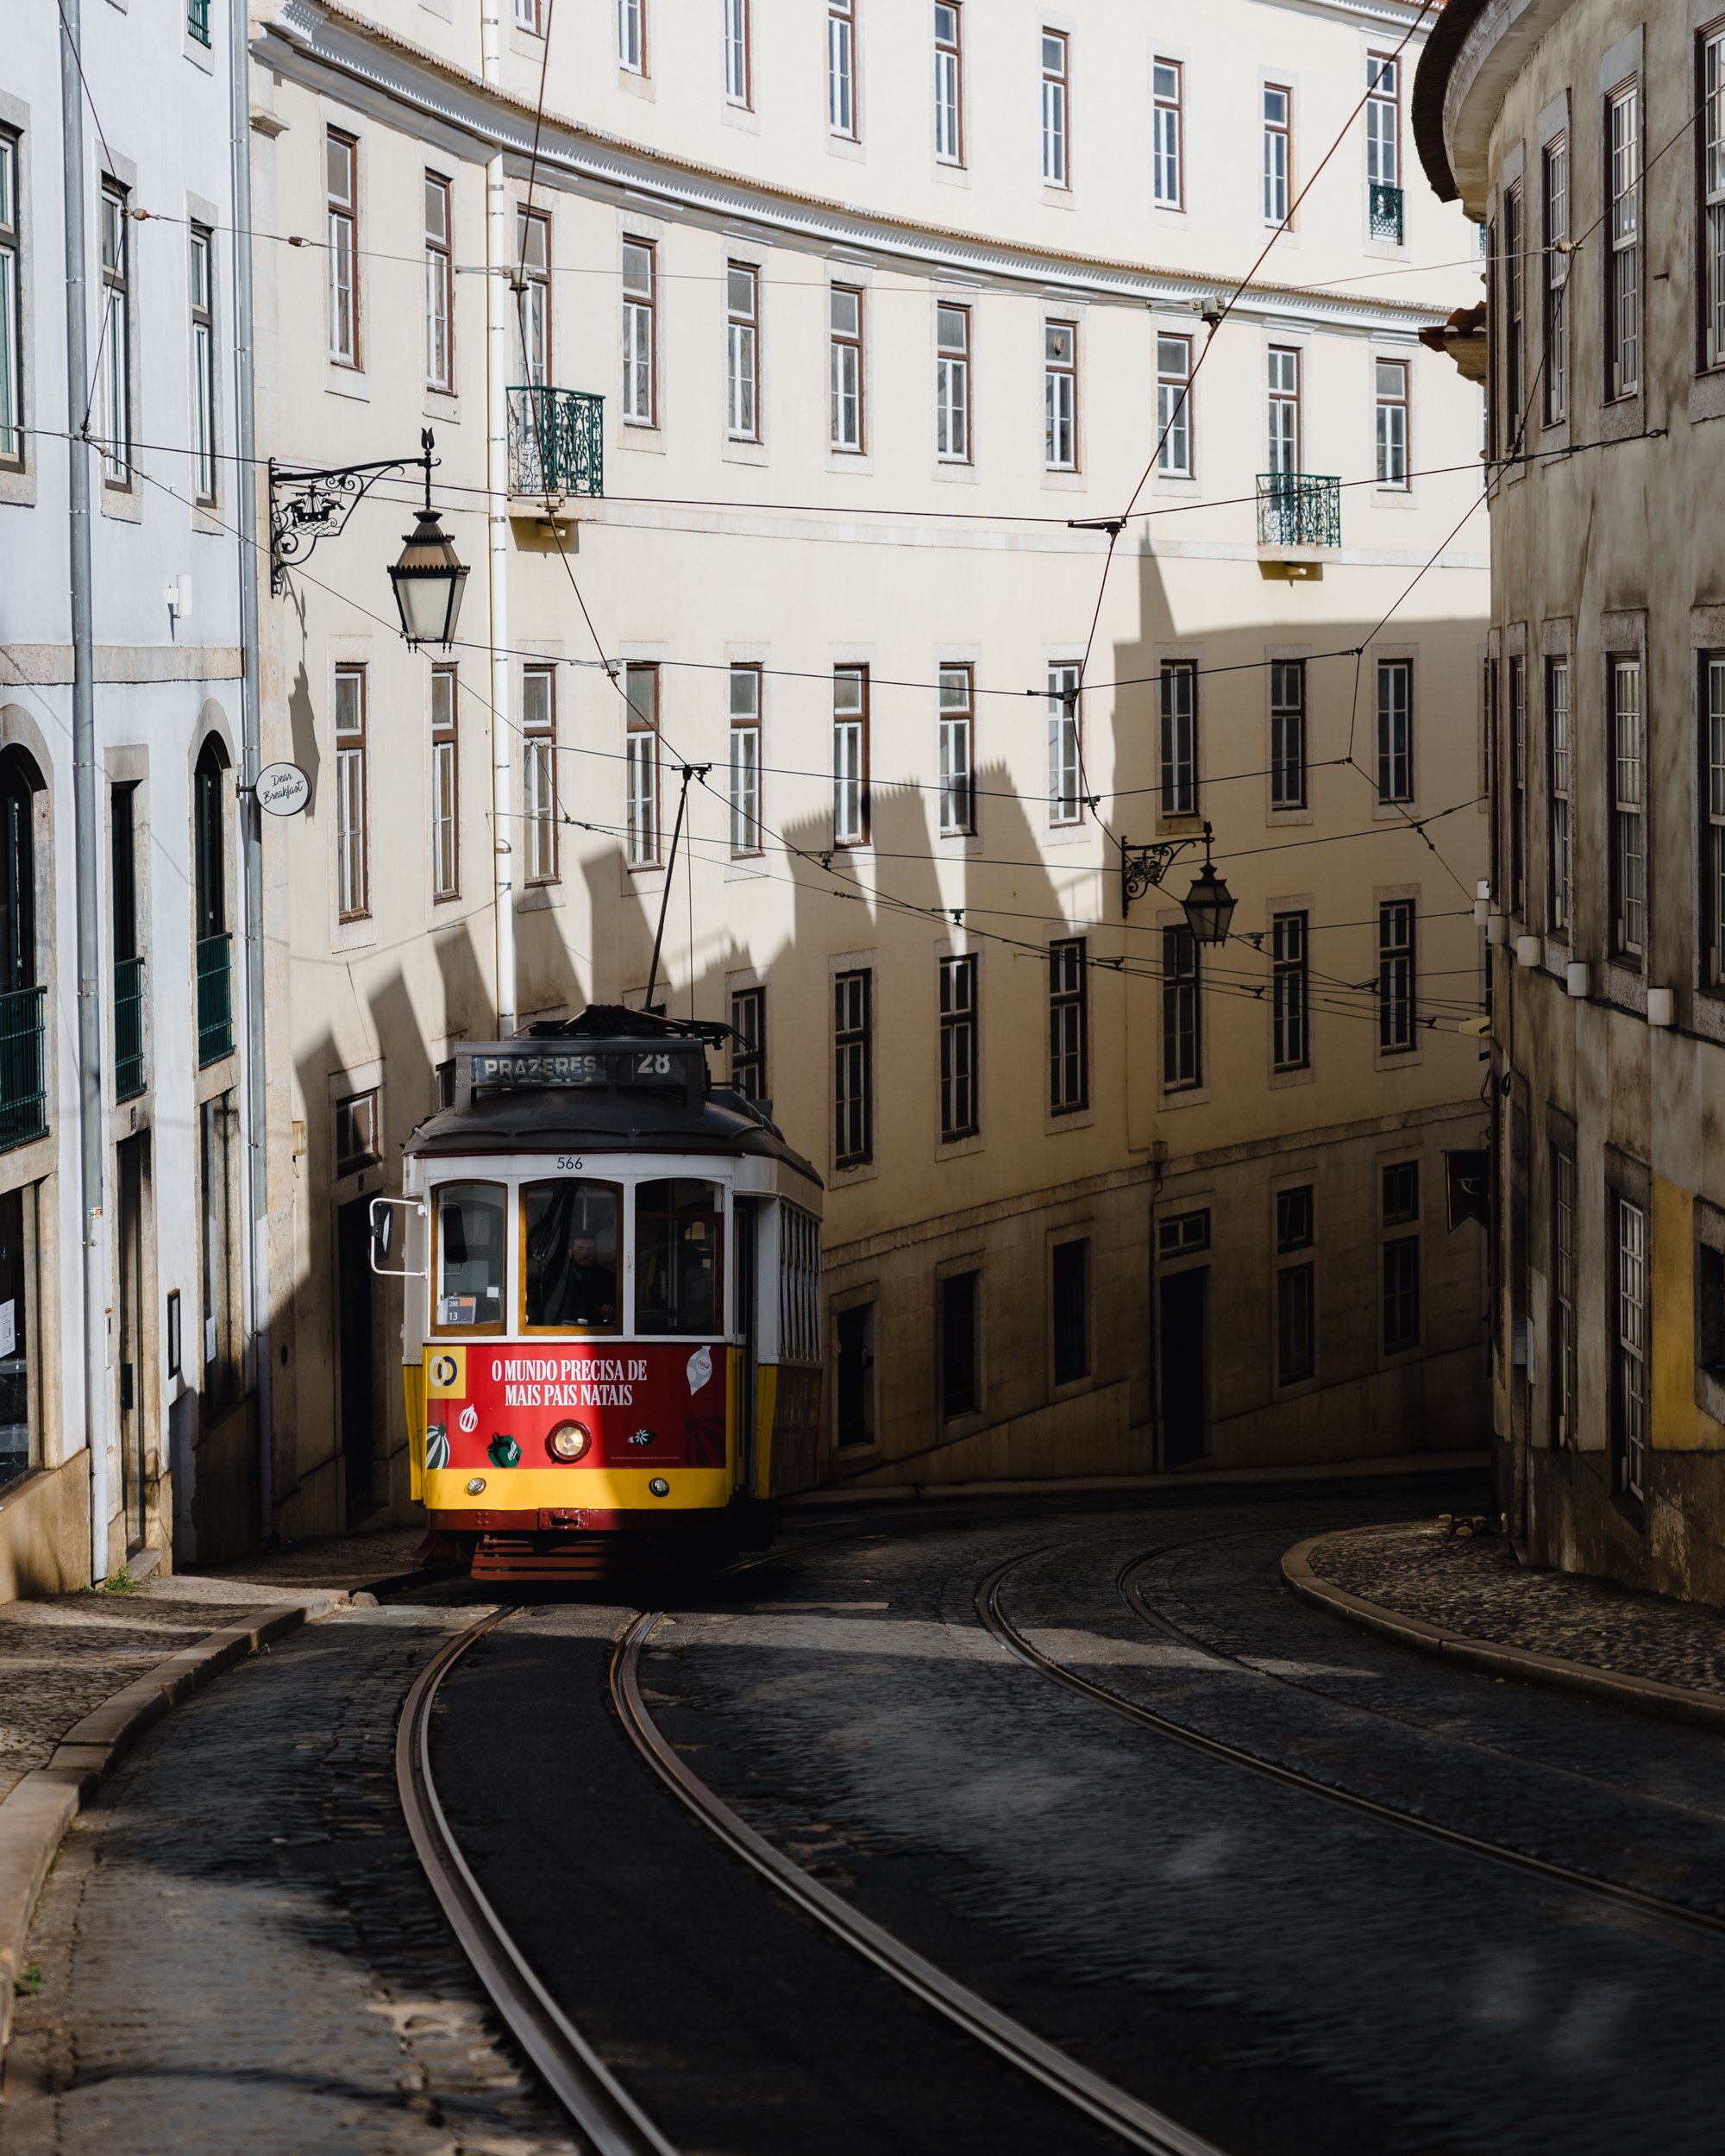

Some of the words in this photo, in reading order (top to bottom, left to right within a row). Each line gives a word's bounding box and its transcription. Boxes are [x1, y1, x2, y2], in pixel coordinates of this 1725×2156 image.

[270, 773, 293, 787] Dear
[262, 780, 304, 805] Breakfast
[484, 1056, 597, 1077] PRAZERES
[637, 1054, 671, 1074] 28
[556, 1156, 583, 1169] 566
[448, 1312, 458, 1320] 13
[492, 1359, 502, 1382] O
[505, 1359, 558, 1382] MUNDO
[561, 1359, 625, 1382] PRECISA
[627, 1359, 647, 1381] DE
[505, 1384, 542, 1406] MAIS
[543, 1384, 578, 1406] PAIS
[580, 1384, 633, 1406] NATAIS
